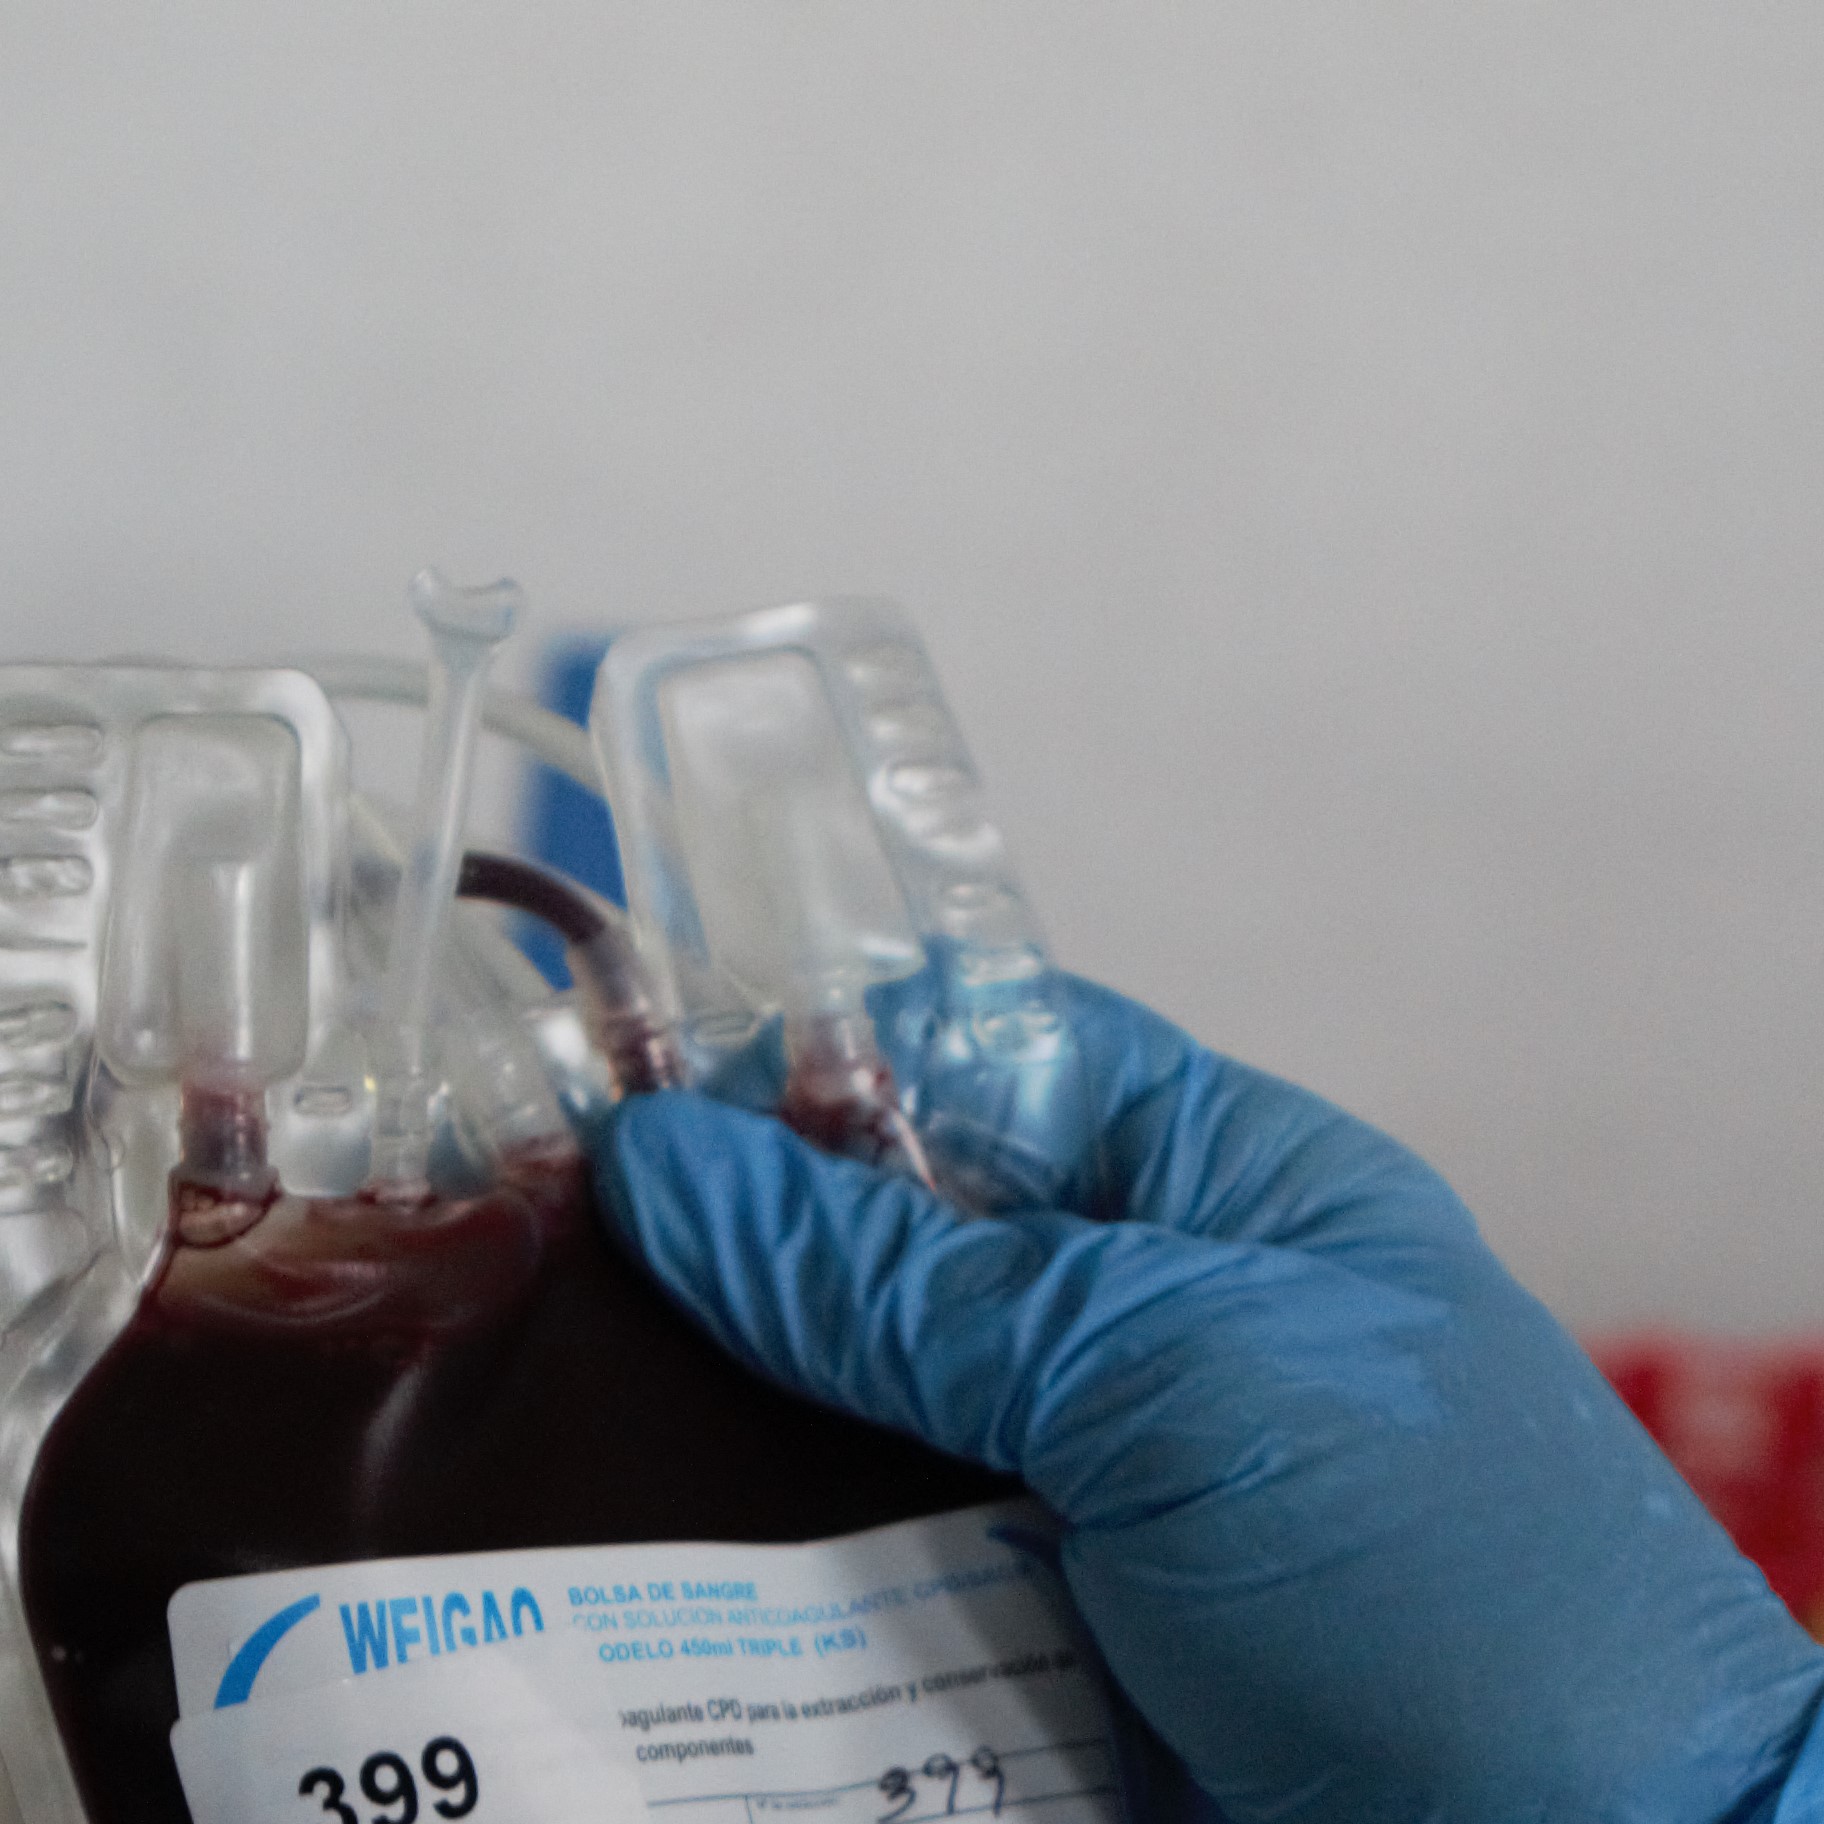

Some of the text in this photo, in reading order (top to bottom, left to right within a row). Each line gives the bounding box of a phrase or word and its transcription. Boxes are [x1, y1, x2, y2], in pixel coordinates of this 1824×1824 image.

[568, 1582, 759, 1604] BOLSA DE SANGRE
[599, 1642, 673, 1662] ODELO
[738, 1637, 802, 1657] TRIPLE
[621, 1704, 704, 1731] agulante
[637, 1737, 755, 1763] componentes
